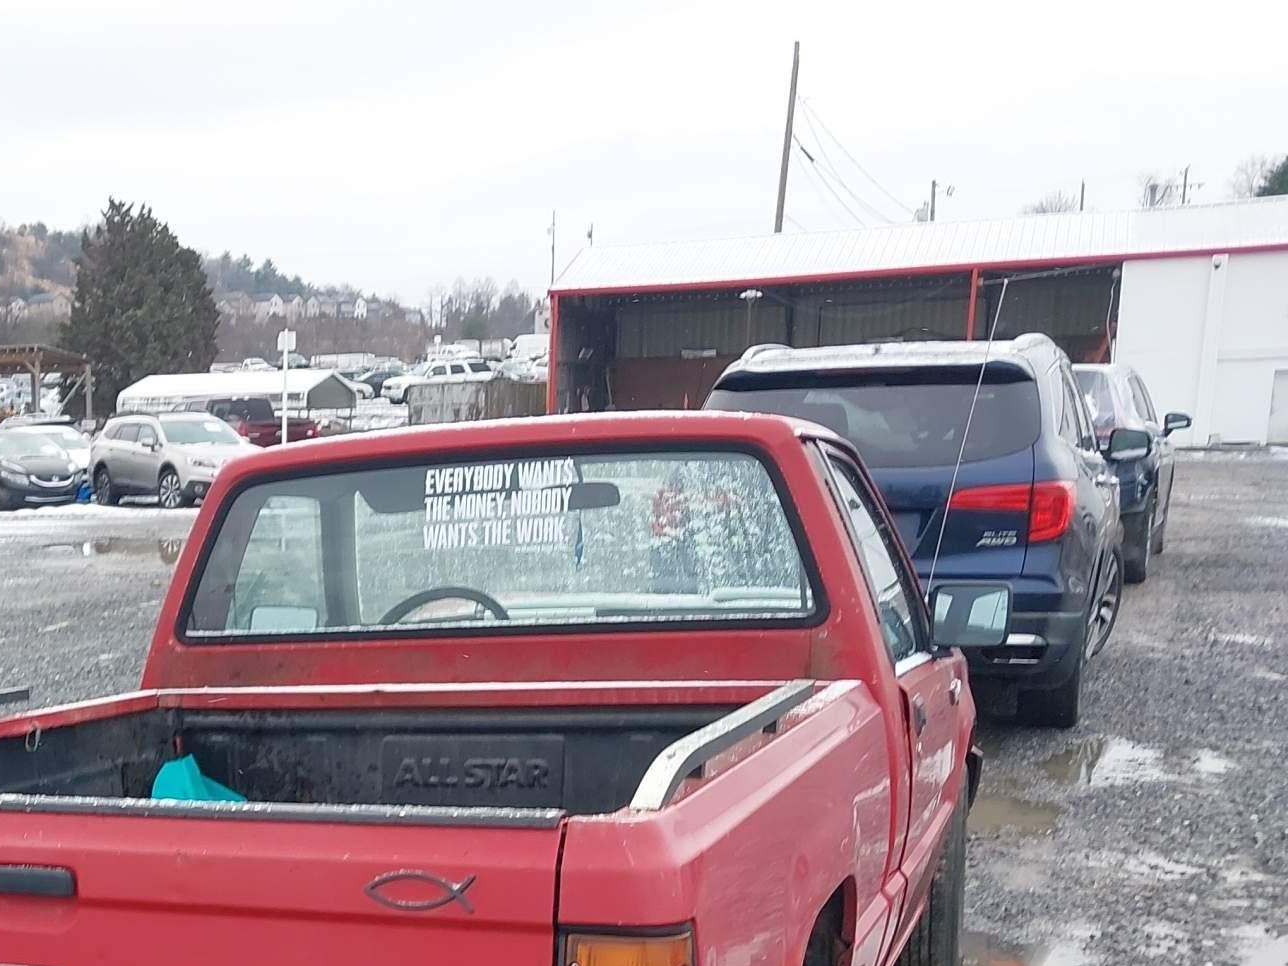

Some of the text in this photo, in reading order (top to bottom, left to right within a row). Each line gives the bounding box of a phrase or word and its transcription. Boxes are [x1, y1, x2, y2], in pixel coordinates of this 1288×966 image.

[425, 463, 513, 495] EVERYBODY
[424, 486, 573, 522] THE MONEY, NOBODY
[423, 515, 570, 550] WANTS THE WORK.
